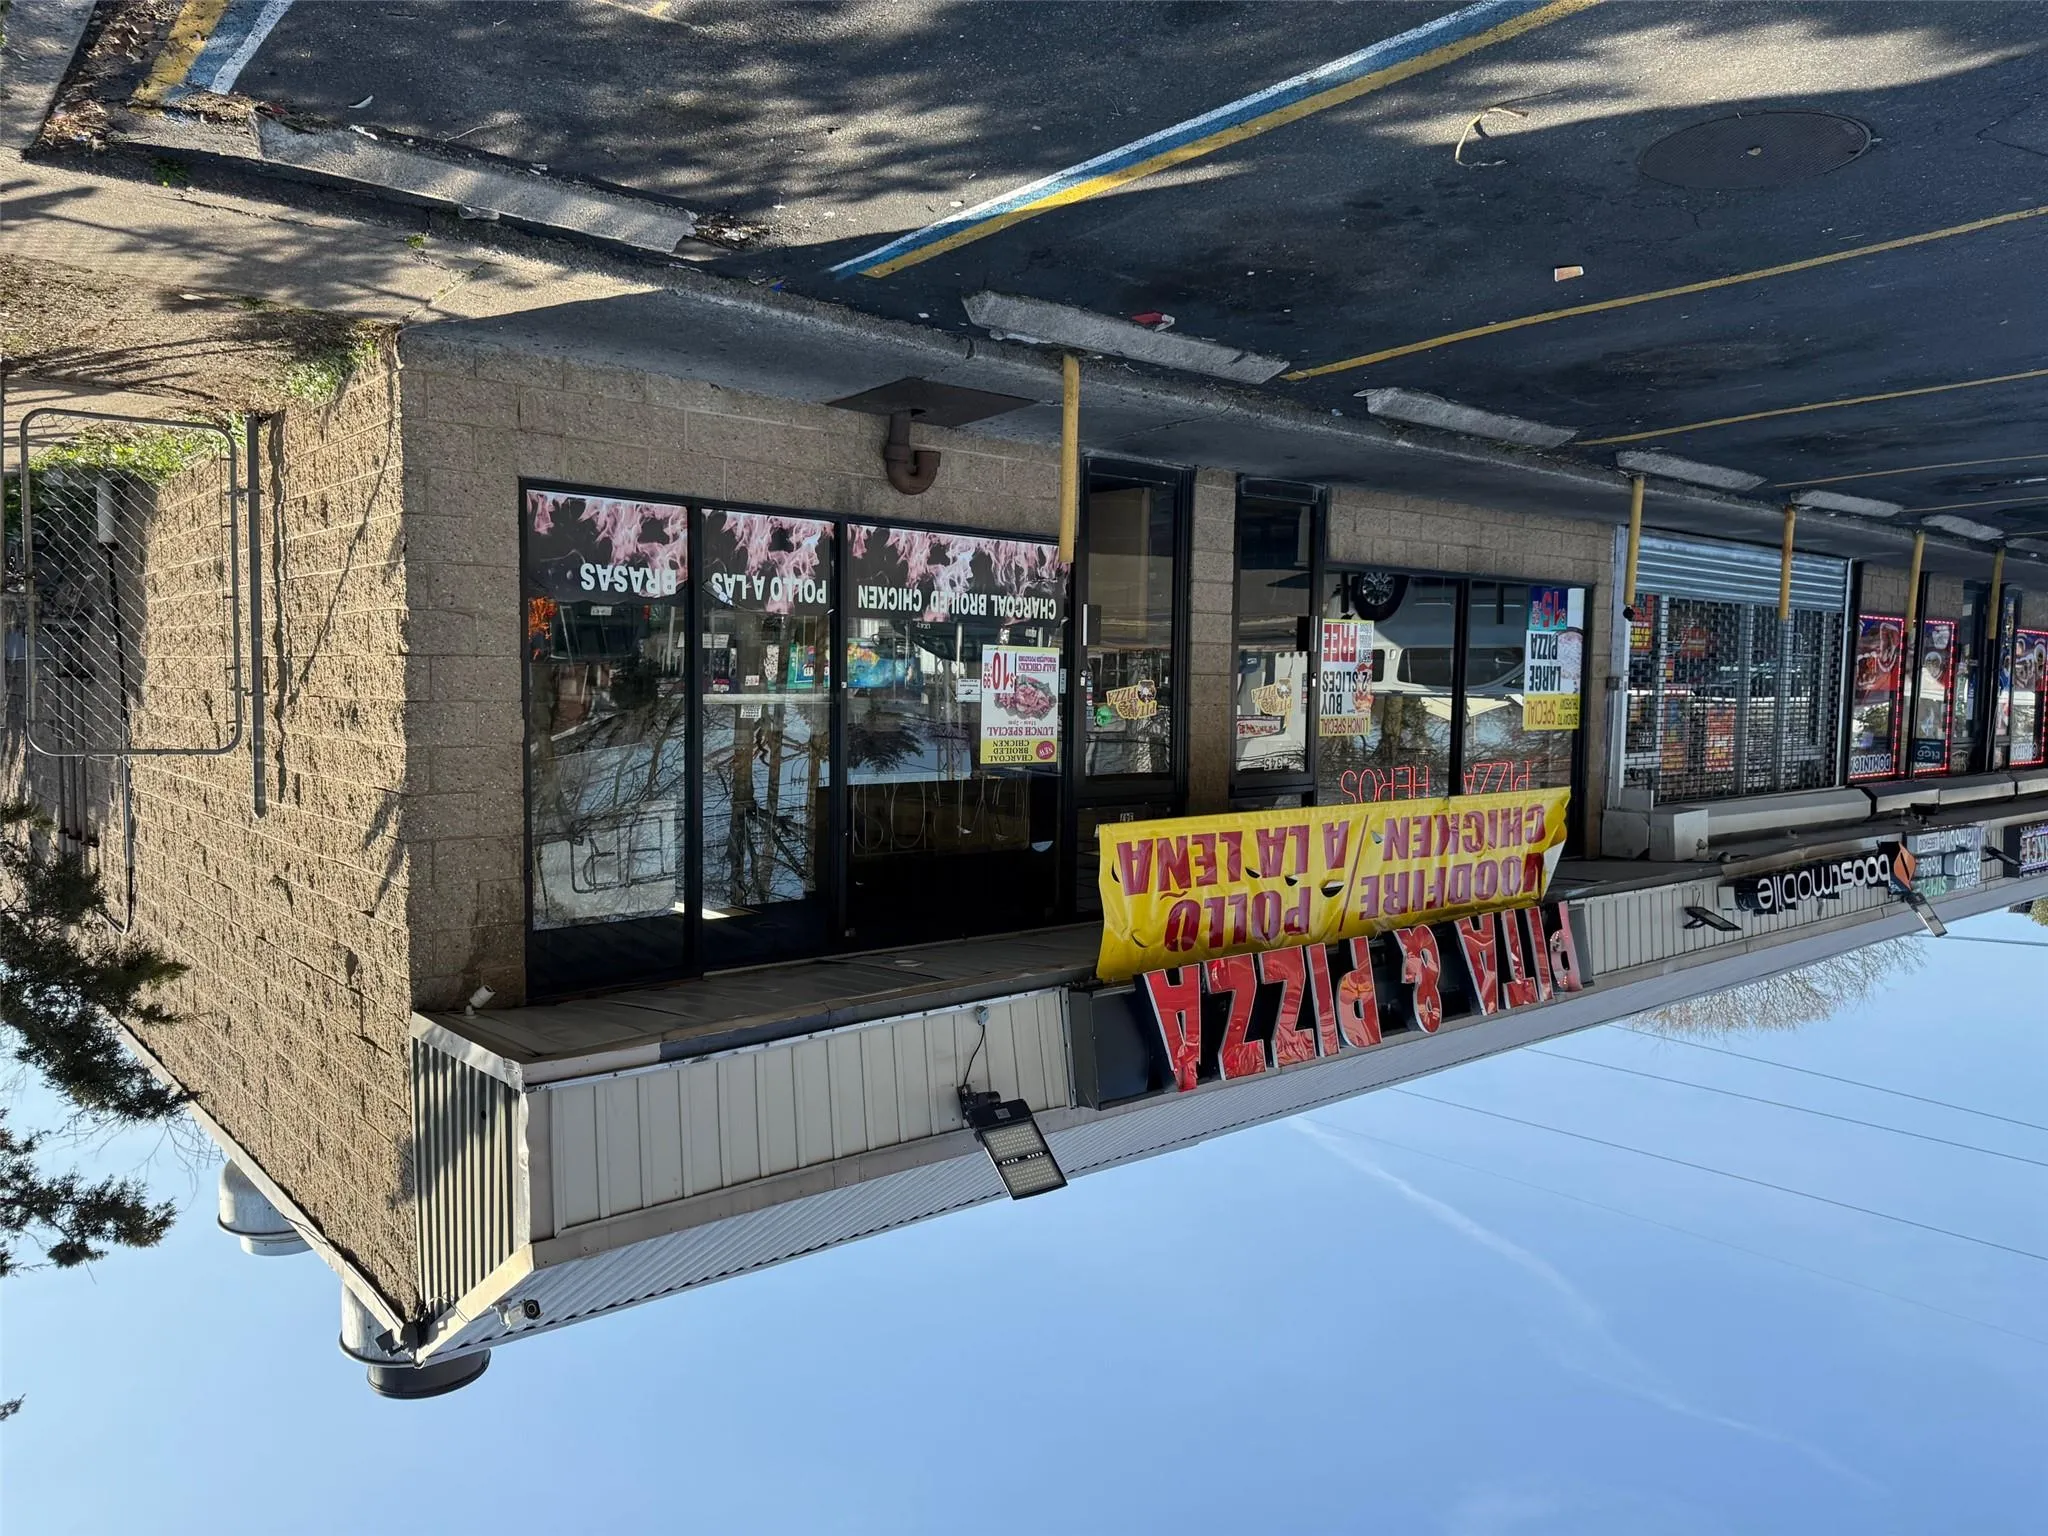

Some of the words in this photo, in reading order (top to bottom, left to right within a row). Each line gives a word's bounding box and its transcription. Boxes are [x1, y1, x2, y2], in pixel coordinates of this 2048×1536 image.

[579, 563, 677, 595] BRASAS
[710, 573, 747, 598] LAS
[753, 576, 766, 600] A
[769, 576, 827, 604] POLLO
[857, 585, 922, 612] CHICKEN
[929, 590, 987, 615] BROILED
[990, 594, 1057, 620] CHARCOAL
[1323, 624, 1357, 662] FREE
[1530, 633, 1558, 660] PIZZA
[1322, 670, 1358, 692] SLICES
[1362, 672, 1368, 692] 2
[1529, 666, 1561, 692] LARGE
[1320, 694, 1342, 715] BUY
[1526, 698, 1556, 725] SPECIAL
[986, 726, 1023, 737] SPECIAL
[1025, 726, 1054, 736] LUNCH
[1320, 718, 1346, 736] SPECIAL
[1348, 718, 1368, 734] LUNCH
[992, 738, 1030, 747] CHICKEN
[993, 746, 1028, 754] BROILED
[987, 754, 1033, 762] CHARCOAL
[1264, 757, 1282, 770] 345
[1339, 765, 1430, 805] HEROS
[1462, 759, 1530, 795] PIZZA
[1320, 821, 1349, 869] A
[1382, 803, 1545, 861] CHICKEN
[1255, 823, 1308, 877] LA
[1116, 830, 1243, 899] LEÑA
[1163, 886, 1311, 952] POLLO
[1454, 902, 1583, 1012] PITA
[1393, 925, 1441, 1034] &
[1144, 936, 1382, 1093] PIZZA
